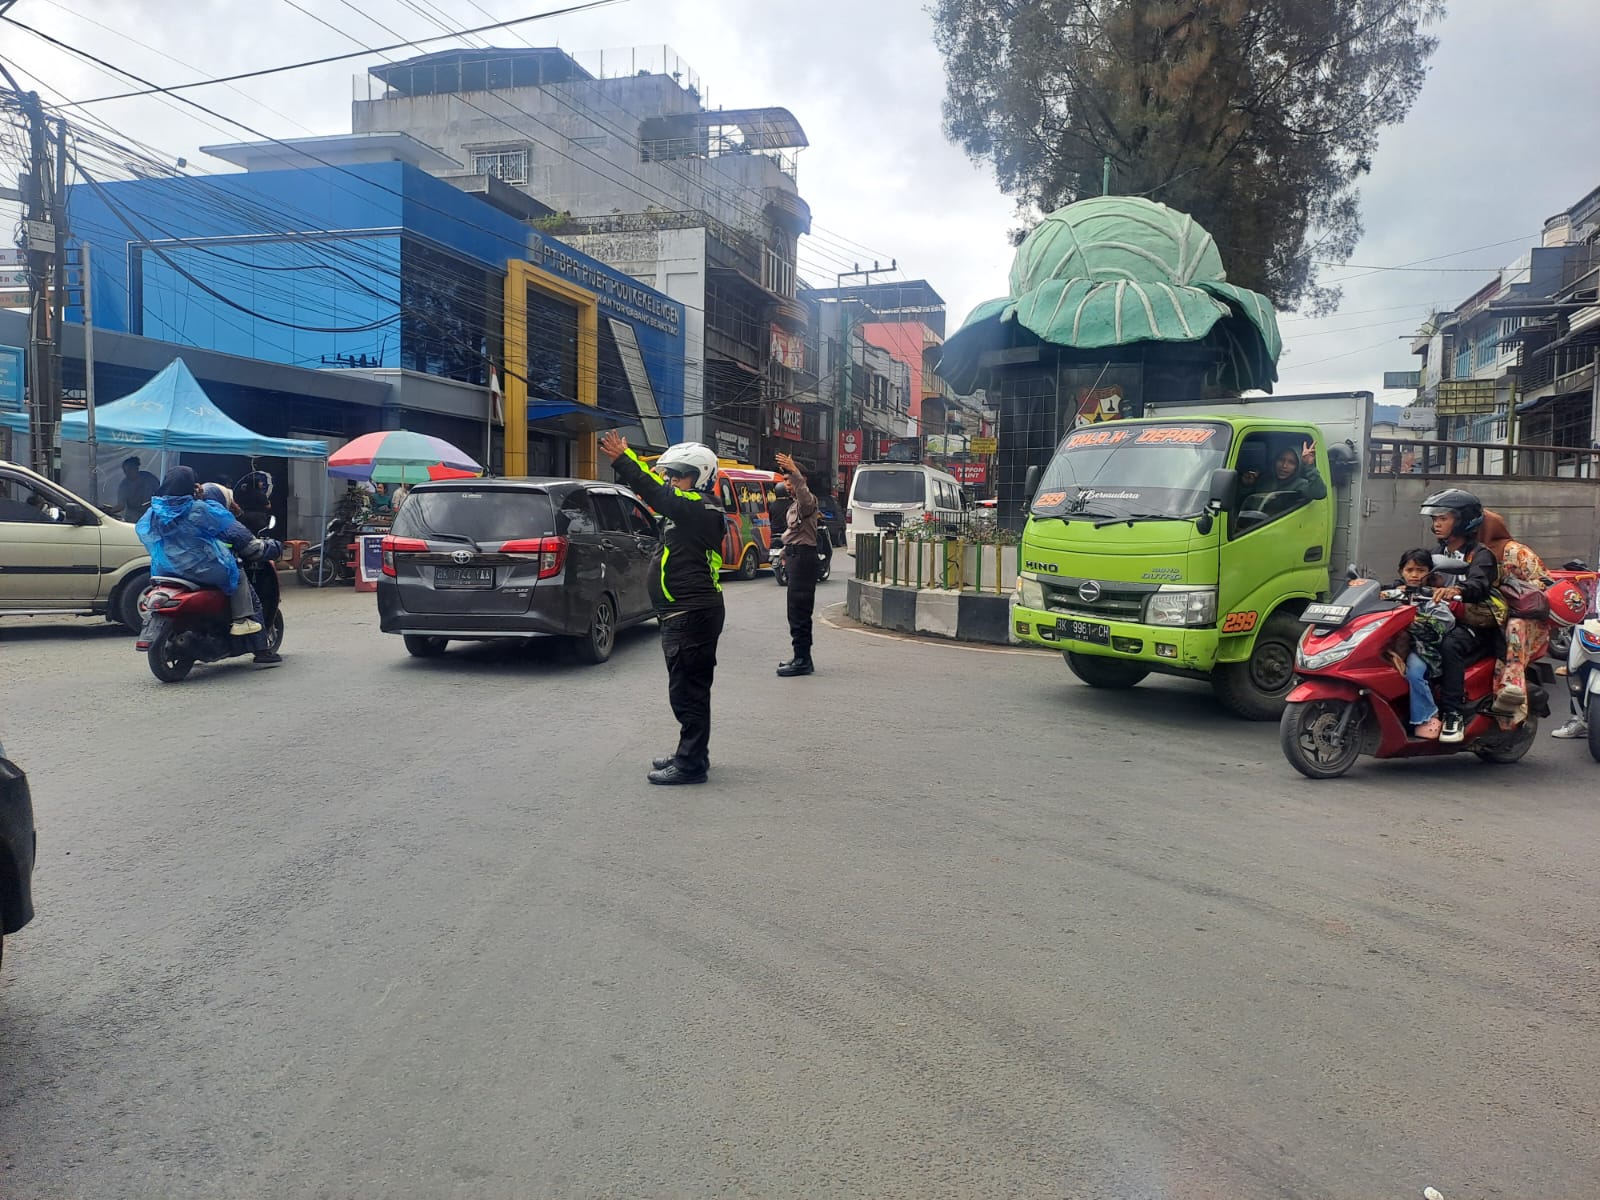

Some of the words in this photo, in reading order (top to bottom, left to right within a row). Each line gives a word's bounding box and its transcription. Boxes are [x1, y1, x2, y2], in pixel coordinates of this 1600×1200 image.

[1136, 428, 1216, 445] DEPARI
[1035, 492, 1066, 507] 299
[1026, 560, 1058, 573] HINO
[1141, 573, 1183, 581] DUTRO
[1222, 611, 1259, 633] 299
[1098, 625, 1109, 638] CH
